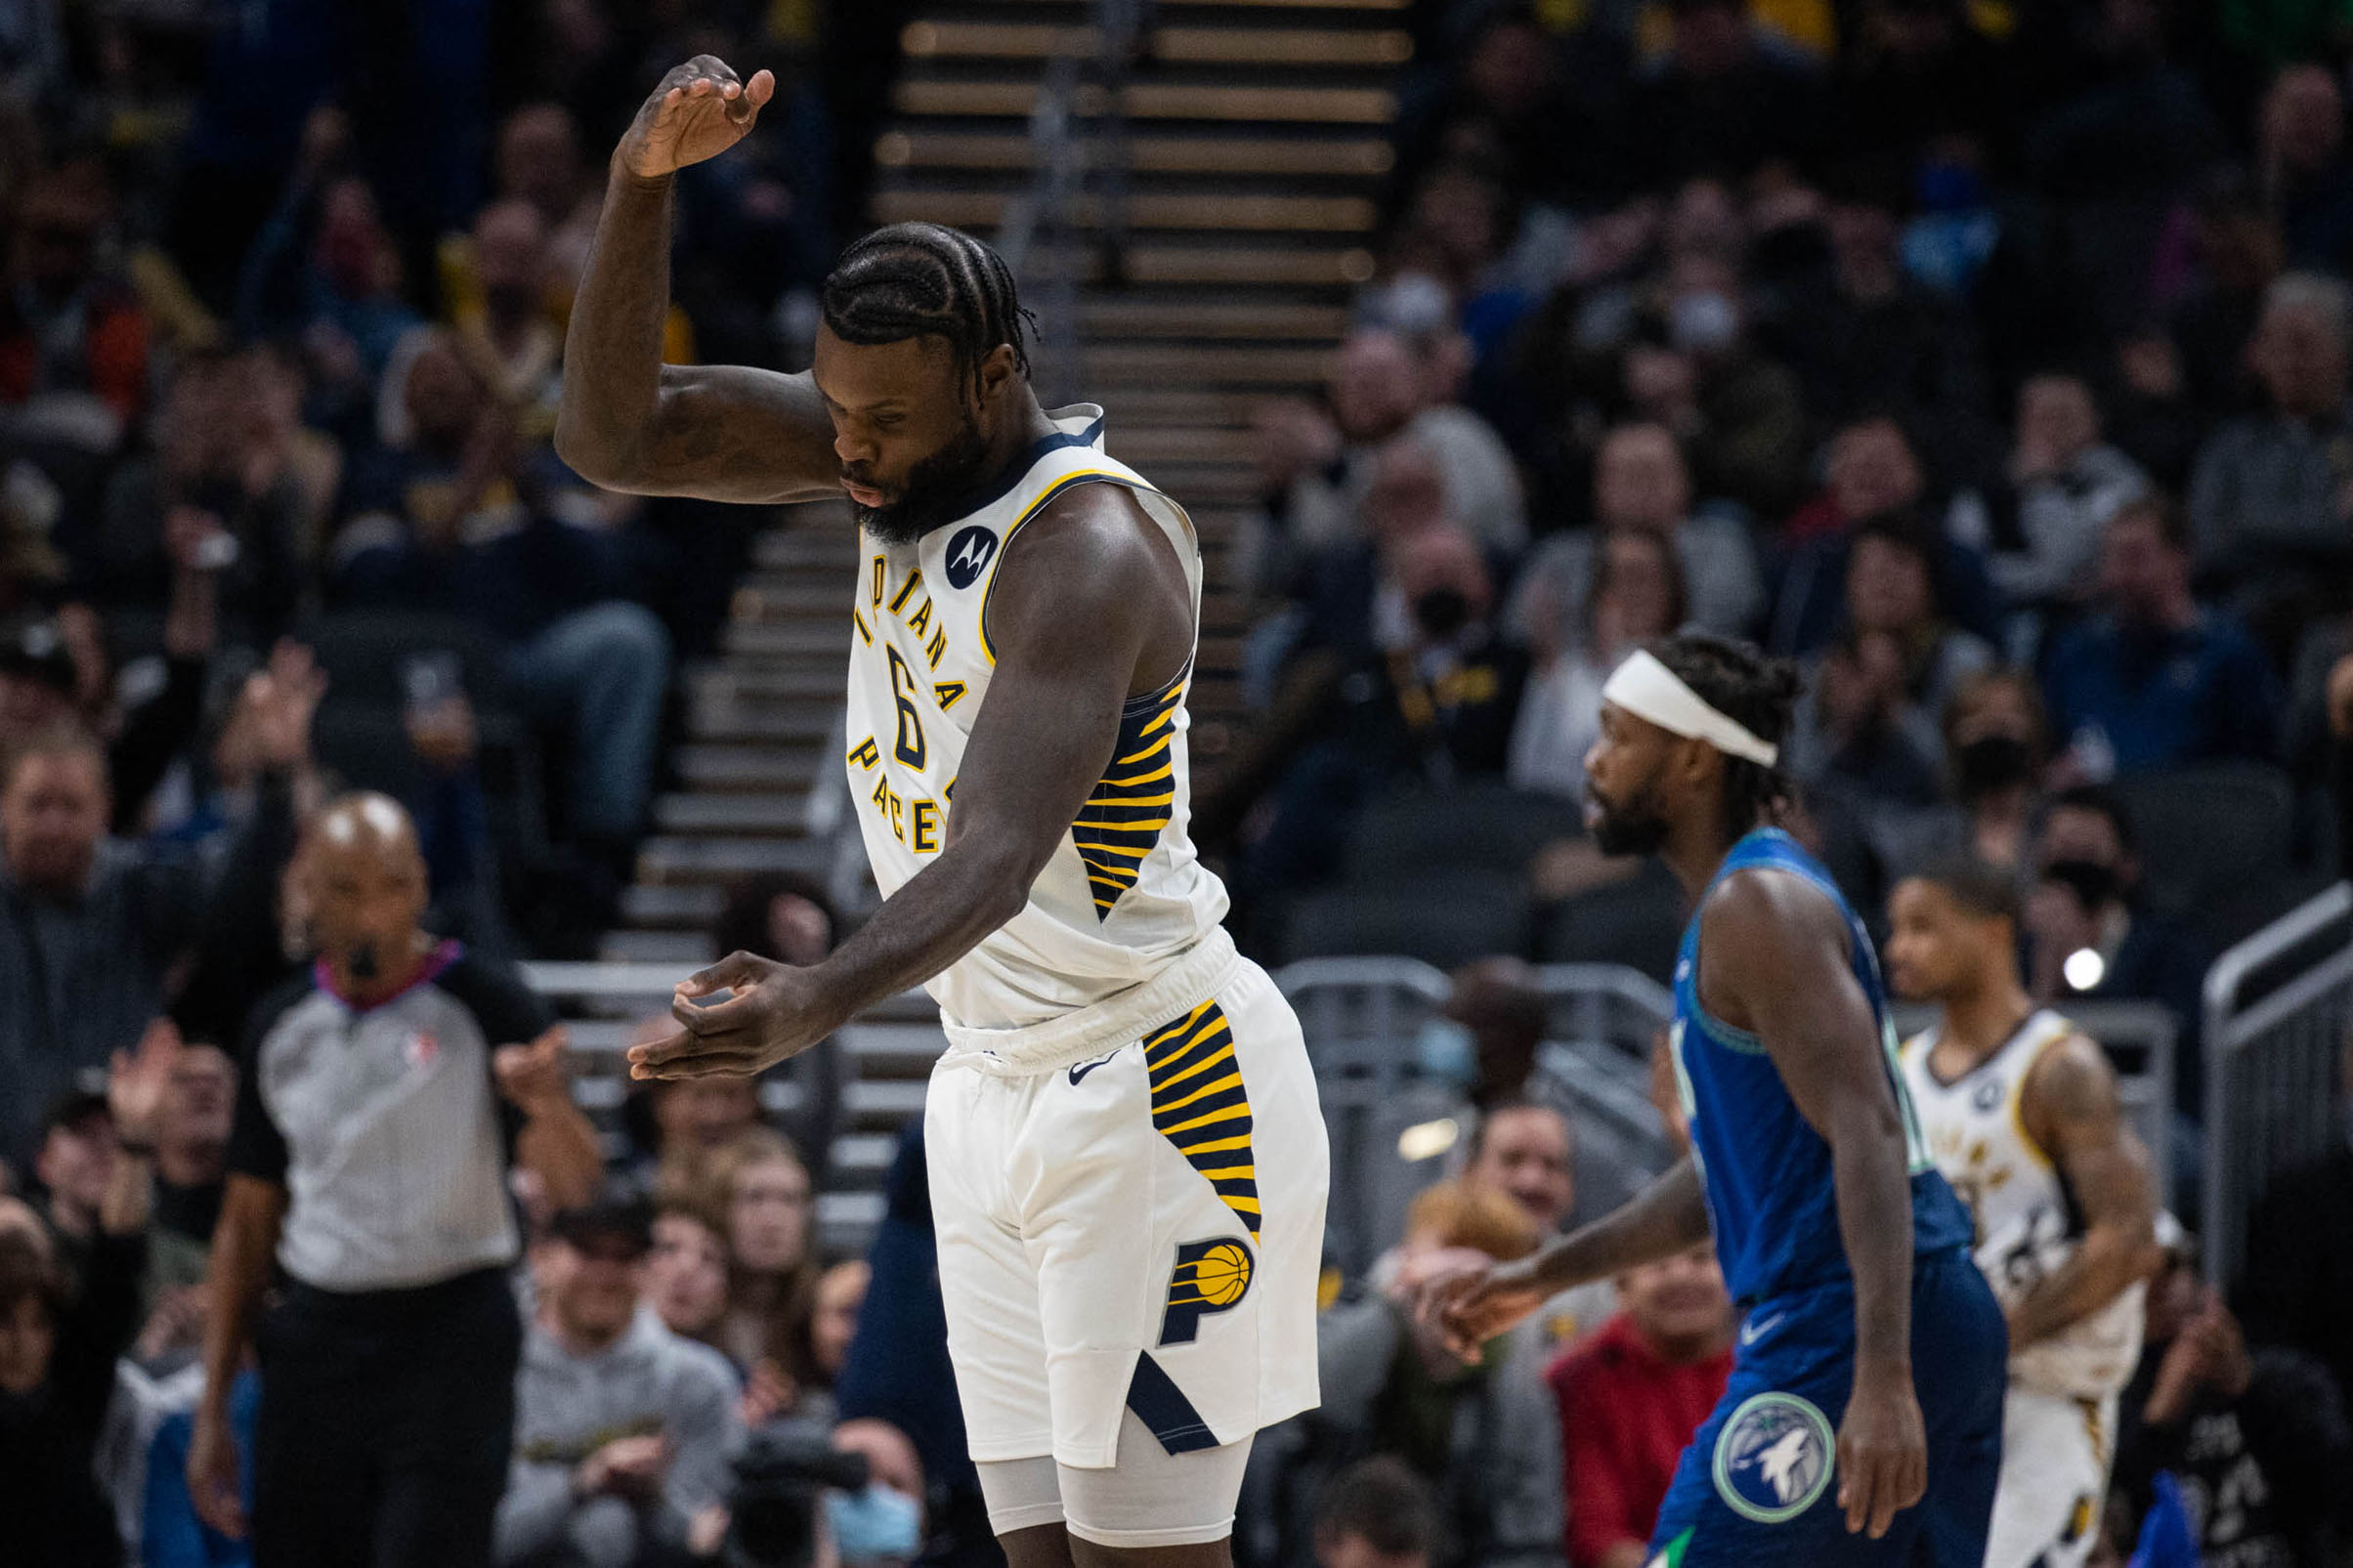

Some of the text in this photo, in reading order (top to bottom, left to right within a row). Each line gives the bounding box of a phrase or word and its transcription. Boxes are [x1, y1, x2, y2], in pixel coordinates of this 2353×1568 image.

[854, 554, 969, 712] IDIANA
[885, 641, 927, 774] 6
[846, 735, 957, 854] PACE
